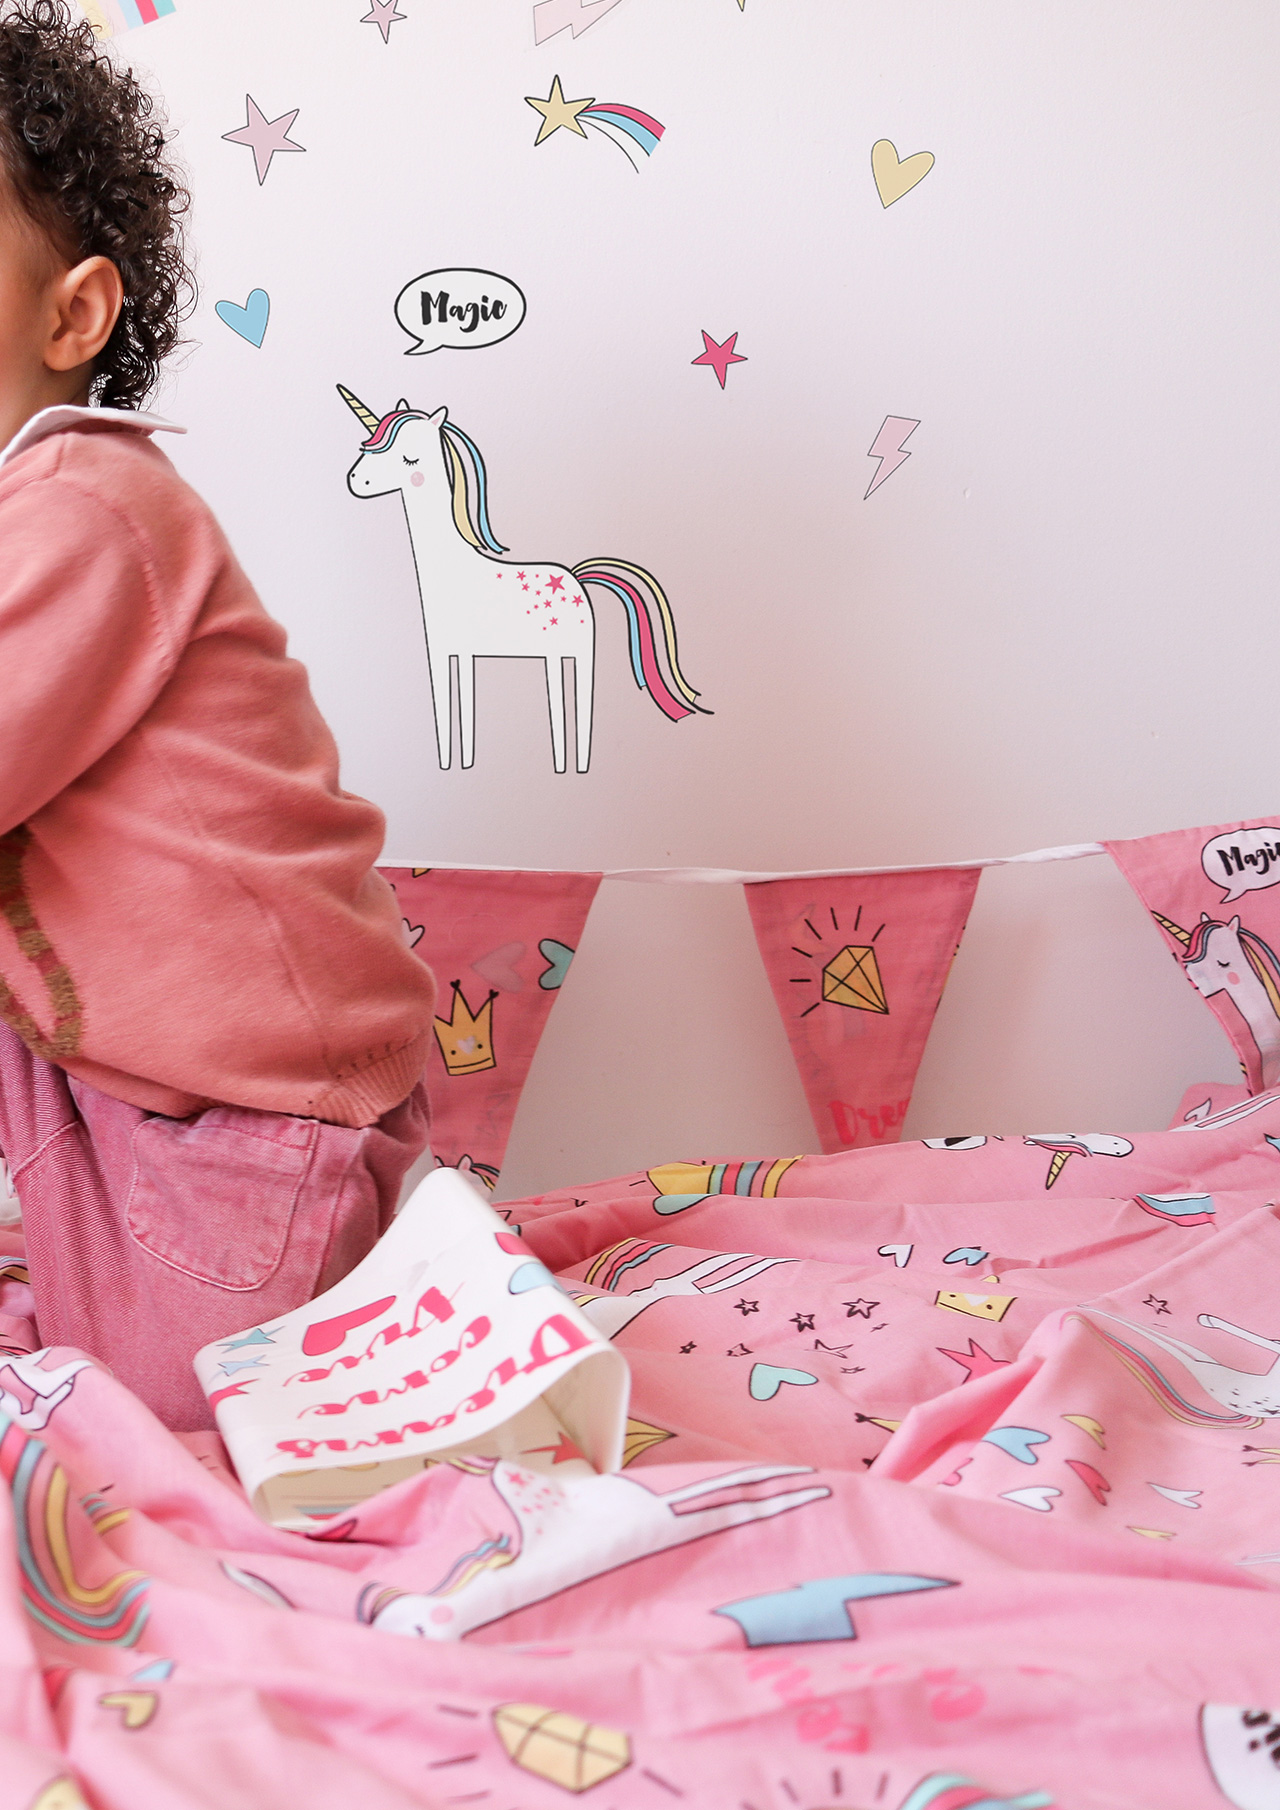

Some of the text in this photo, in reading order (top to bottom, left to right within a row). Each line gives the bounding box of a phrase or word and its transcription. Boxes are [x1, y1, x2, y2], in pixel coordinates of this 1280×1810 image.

[421, 290, 508, 333] Magic
[283, 1282, 466, 1387] true
[297, 1315, 492, 1419] come
[268, 1313, 595, 1461] Dreams
